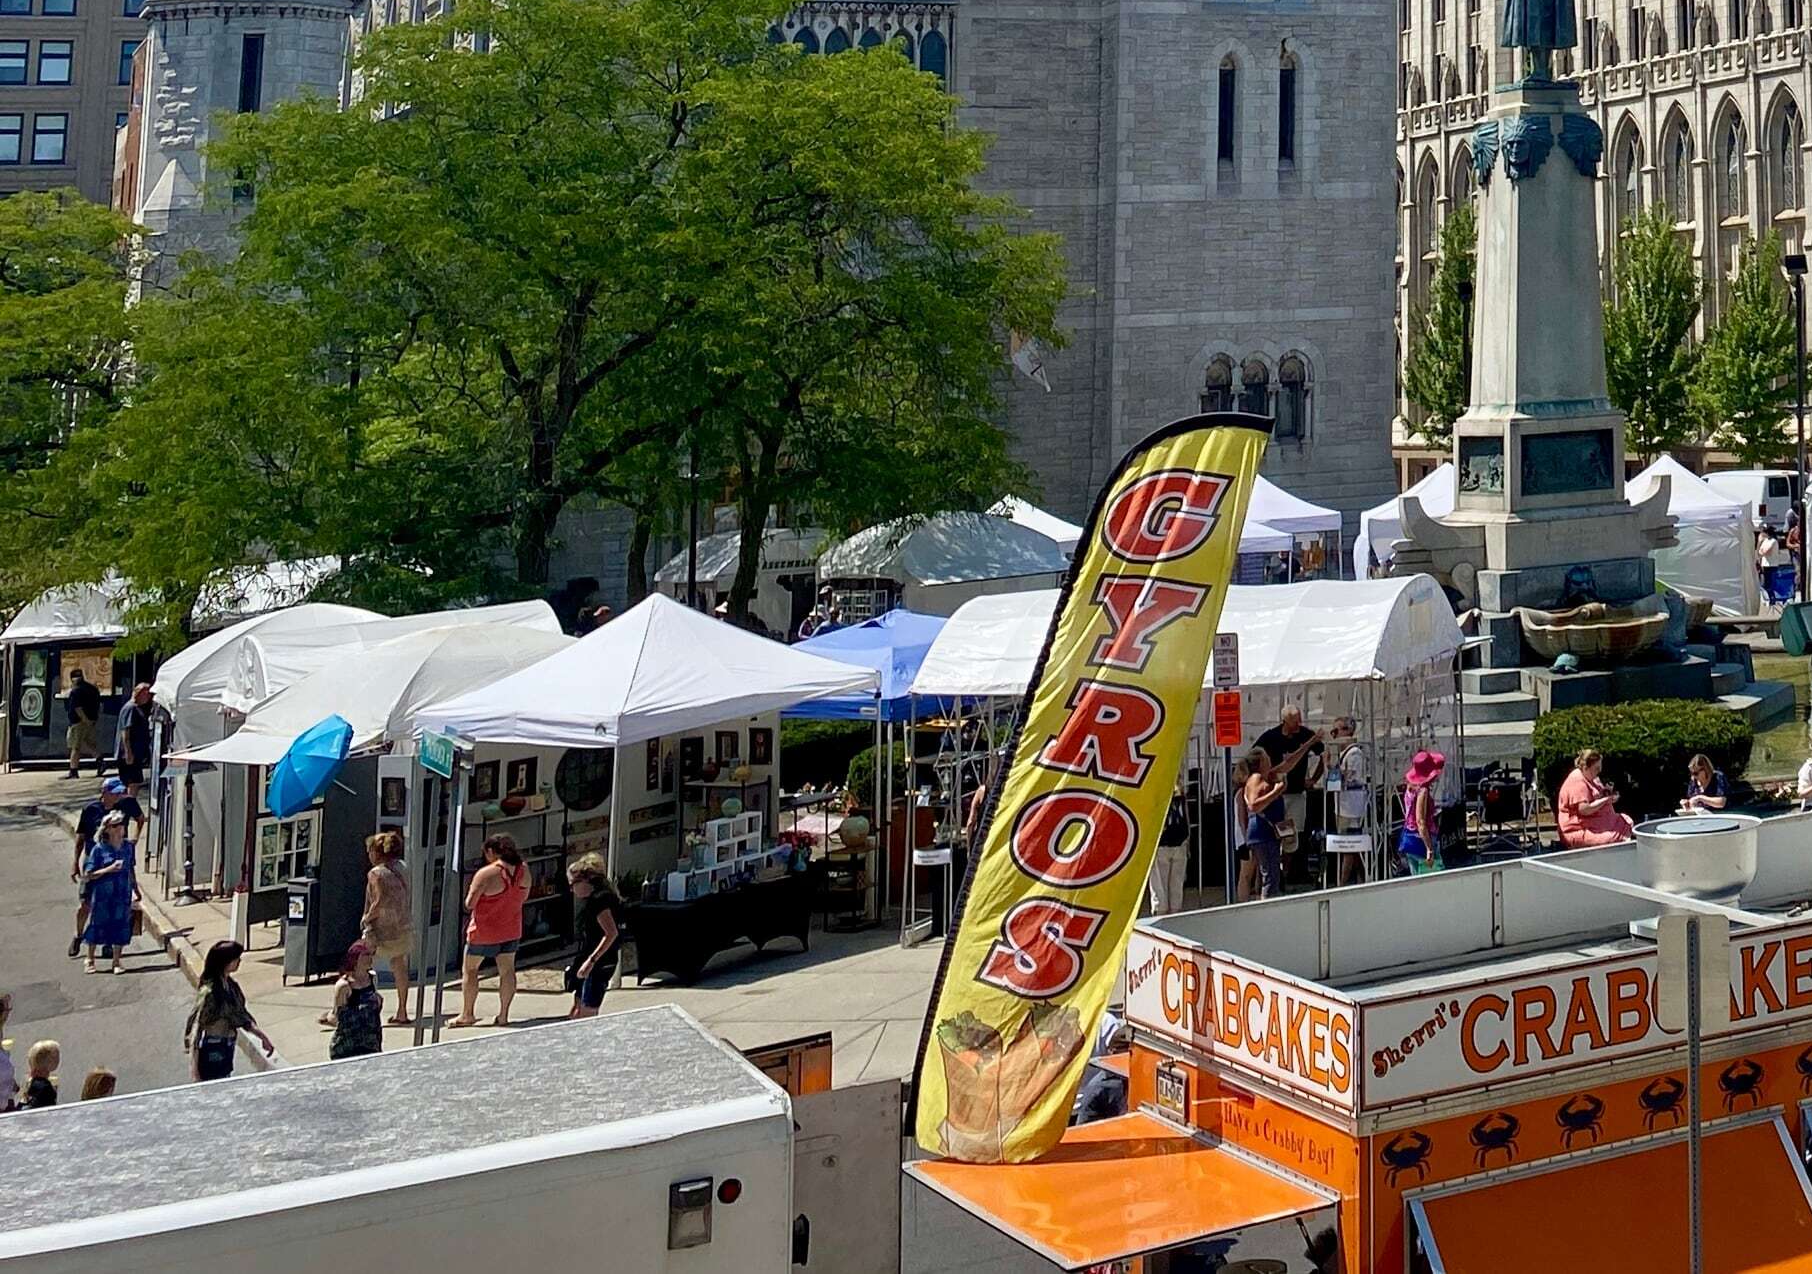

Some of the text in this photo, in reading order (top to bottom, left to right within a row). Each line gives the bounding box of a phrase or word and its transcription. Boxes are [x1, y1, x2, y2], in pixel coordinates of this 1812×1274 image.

[975, 467, 1235, 1001] GYROS
[1161, 952, 1352, 1094] CRABCAKES
[1371, 999, 1462, 1079] Sherri's
[1262, 1117, 1306, 1163] Crabby
[1308, 1137, 1336, 1175] Day!
